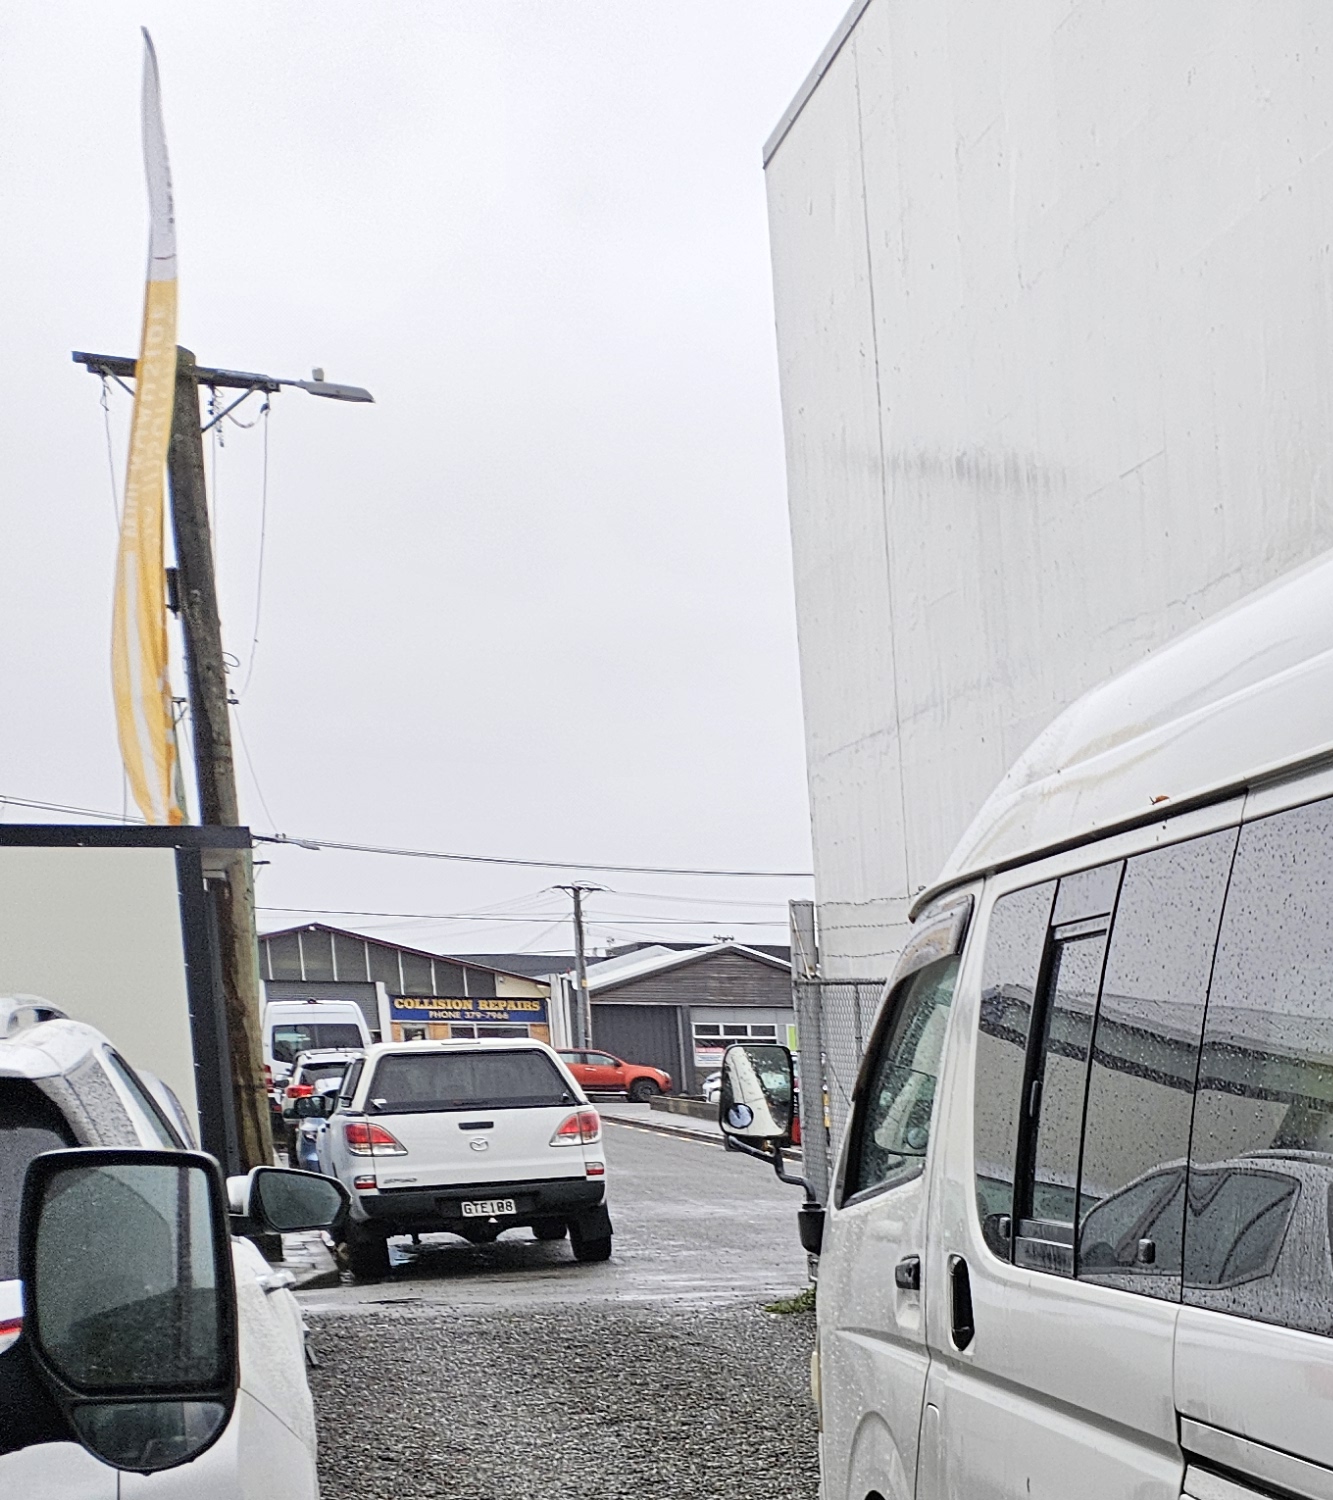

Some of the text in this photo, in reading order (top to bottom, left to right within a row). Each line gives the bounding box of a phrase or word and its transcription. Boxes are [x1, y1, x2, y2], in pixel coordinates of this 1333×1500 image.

[394, 999, 540, 1011] COLLISION REPAIRS
[429, 1010, 462, 1019] PHONE
